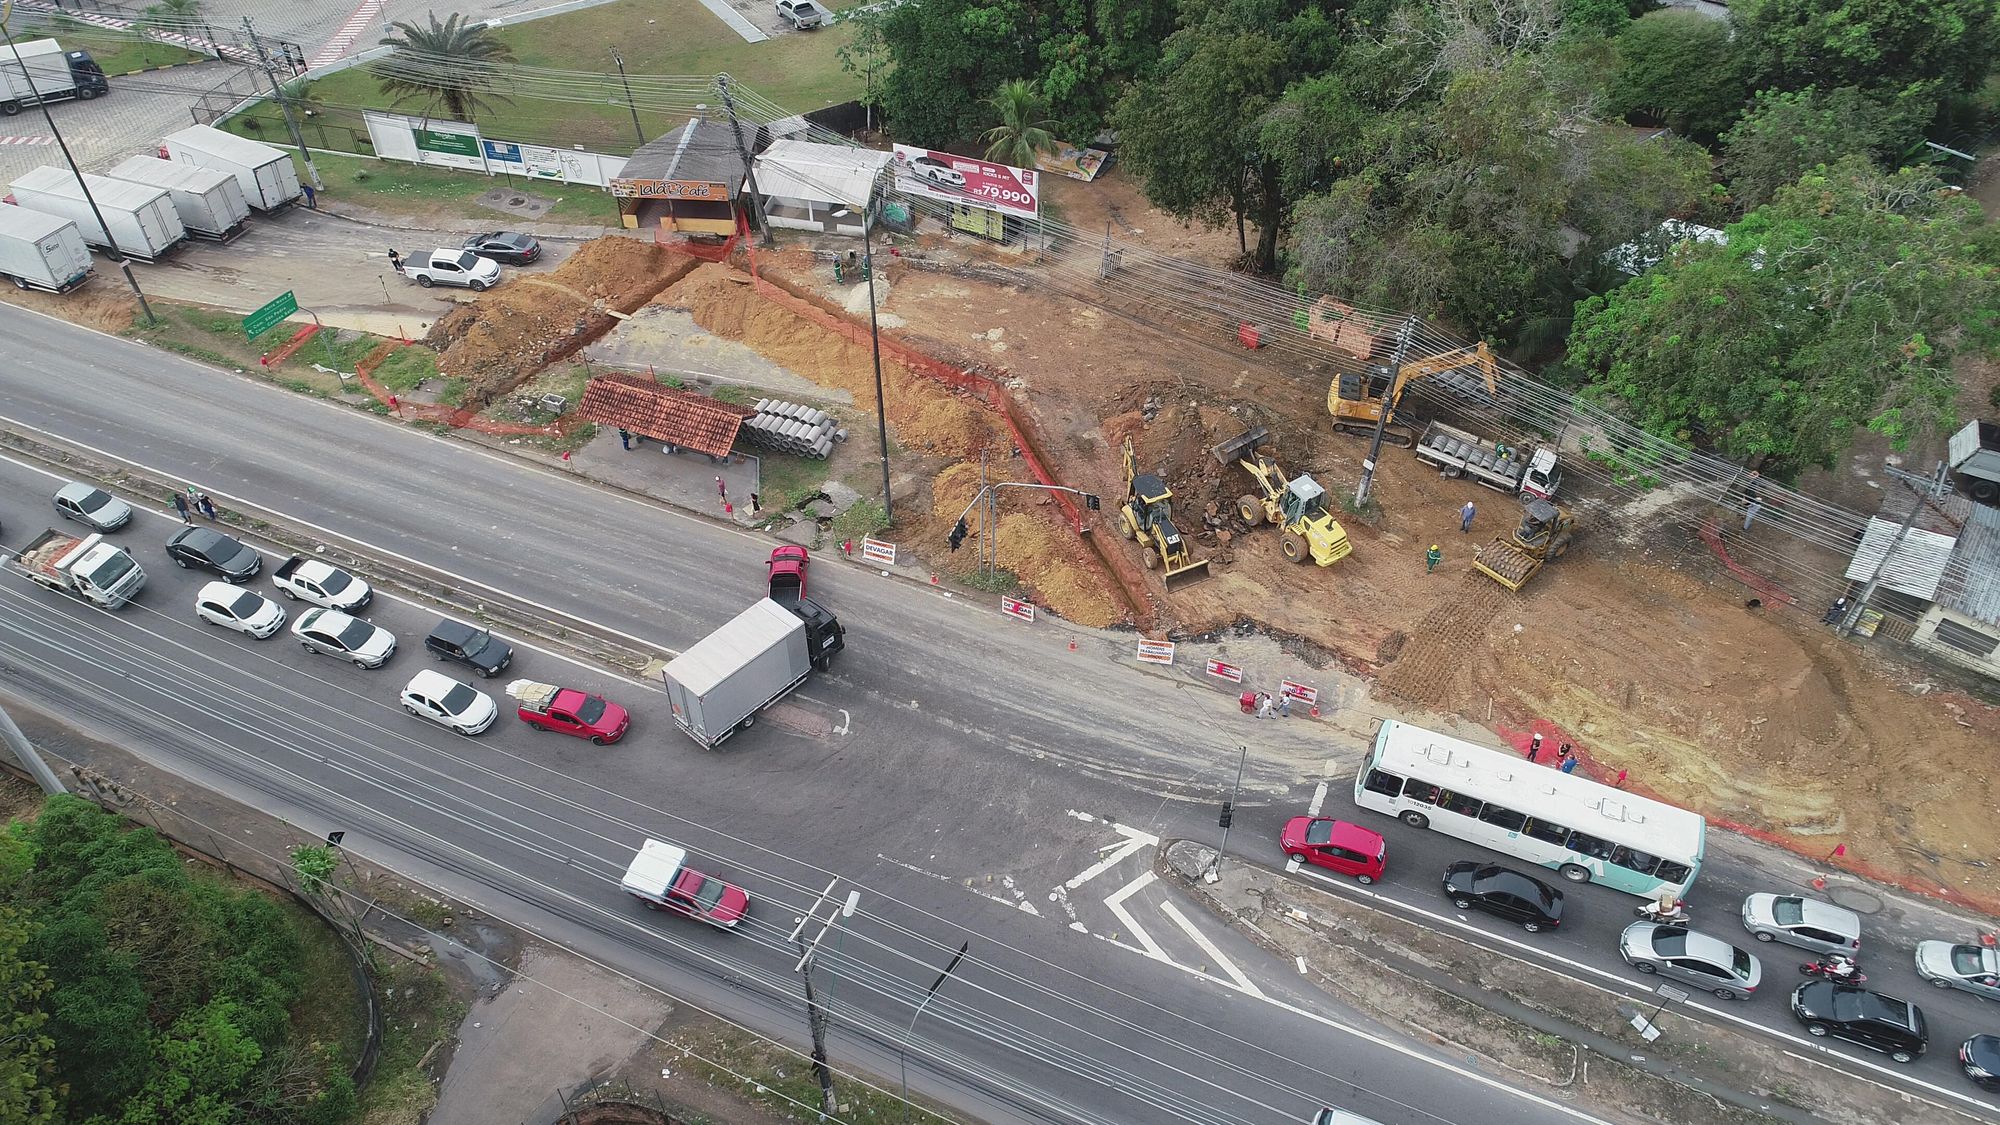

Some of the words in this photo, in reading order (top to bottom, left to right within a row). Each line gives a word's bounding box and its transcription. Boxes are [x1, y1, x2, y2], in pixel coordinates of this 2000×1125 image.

[639, 182, 667, 196] Lalá
[679, 184, 710, 197] Café
[1168, 534, 1180, 544] CAT
[865, 544, 894, 556] DEVAGAR
[1003, 602, 1032, 614] DEVGAR
